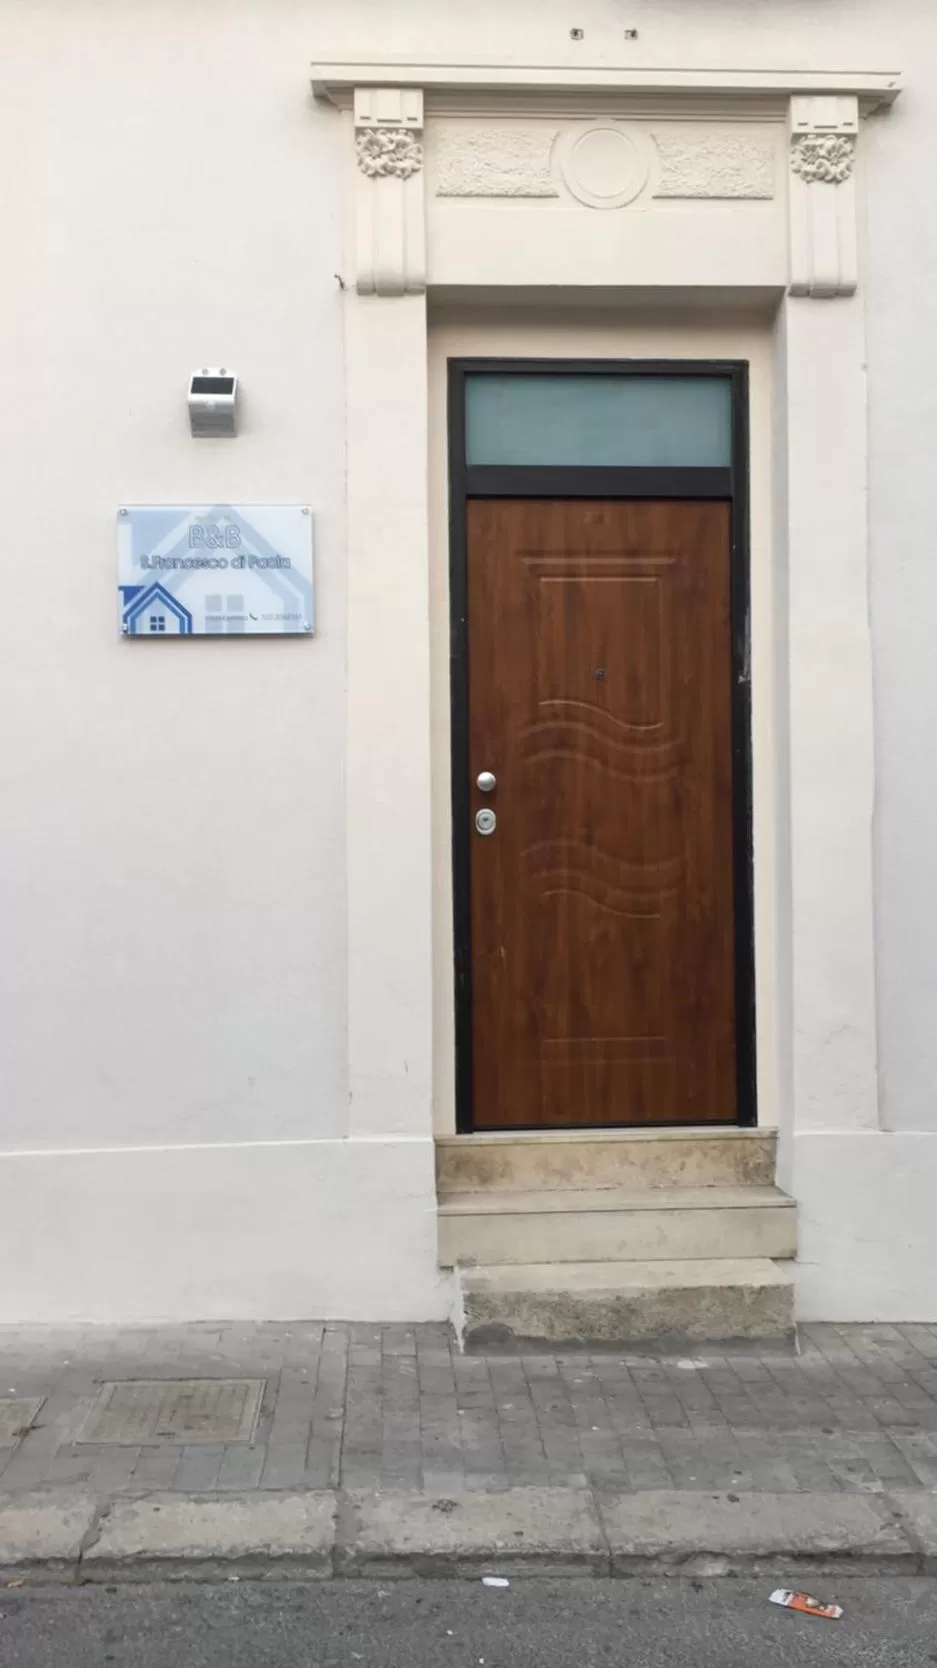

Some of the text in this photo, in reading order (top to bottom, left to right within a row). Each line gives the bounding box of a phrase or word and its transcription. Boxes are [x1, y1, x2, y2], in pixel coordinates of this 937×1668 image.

[188, 524, 241, 549] B&B
[230, 555, 246, 569] di
[247, 554, 291, 569] Paola
